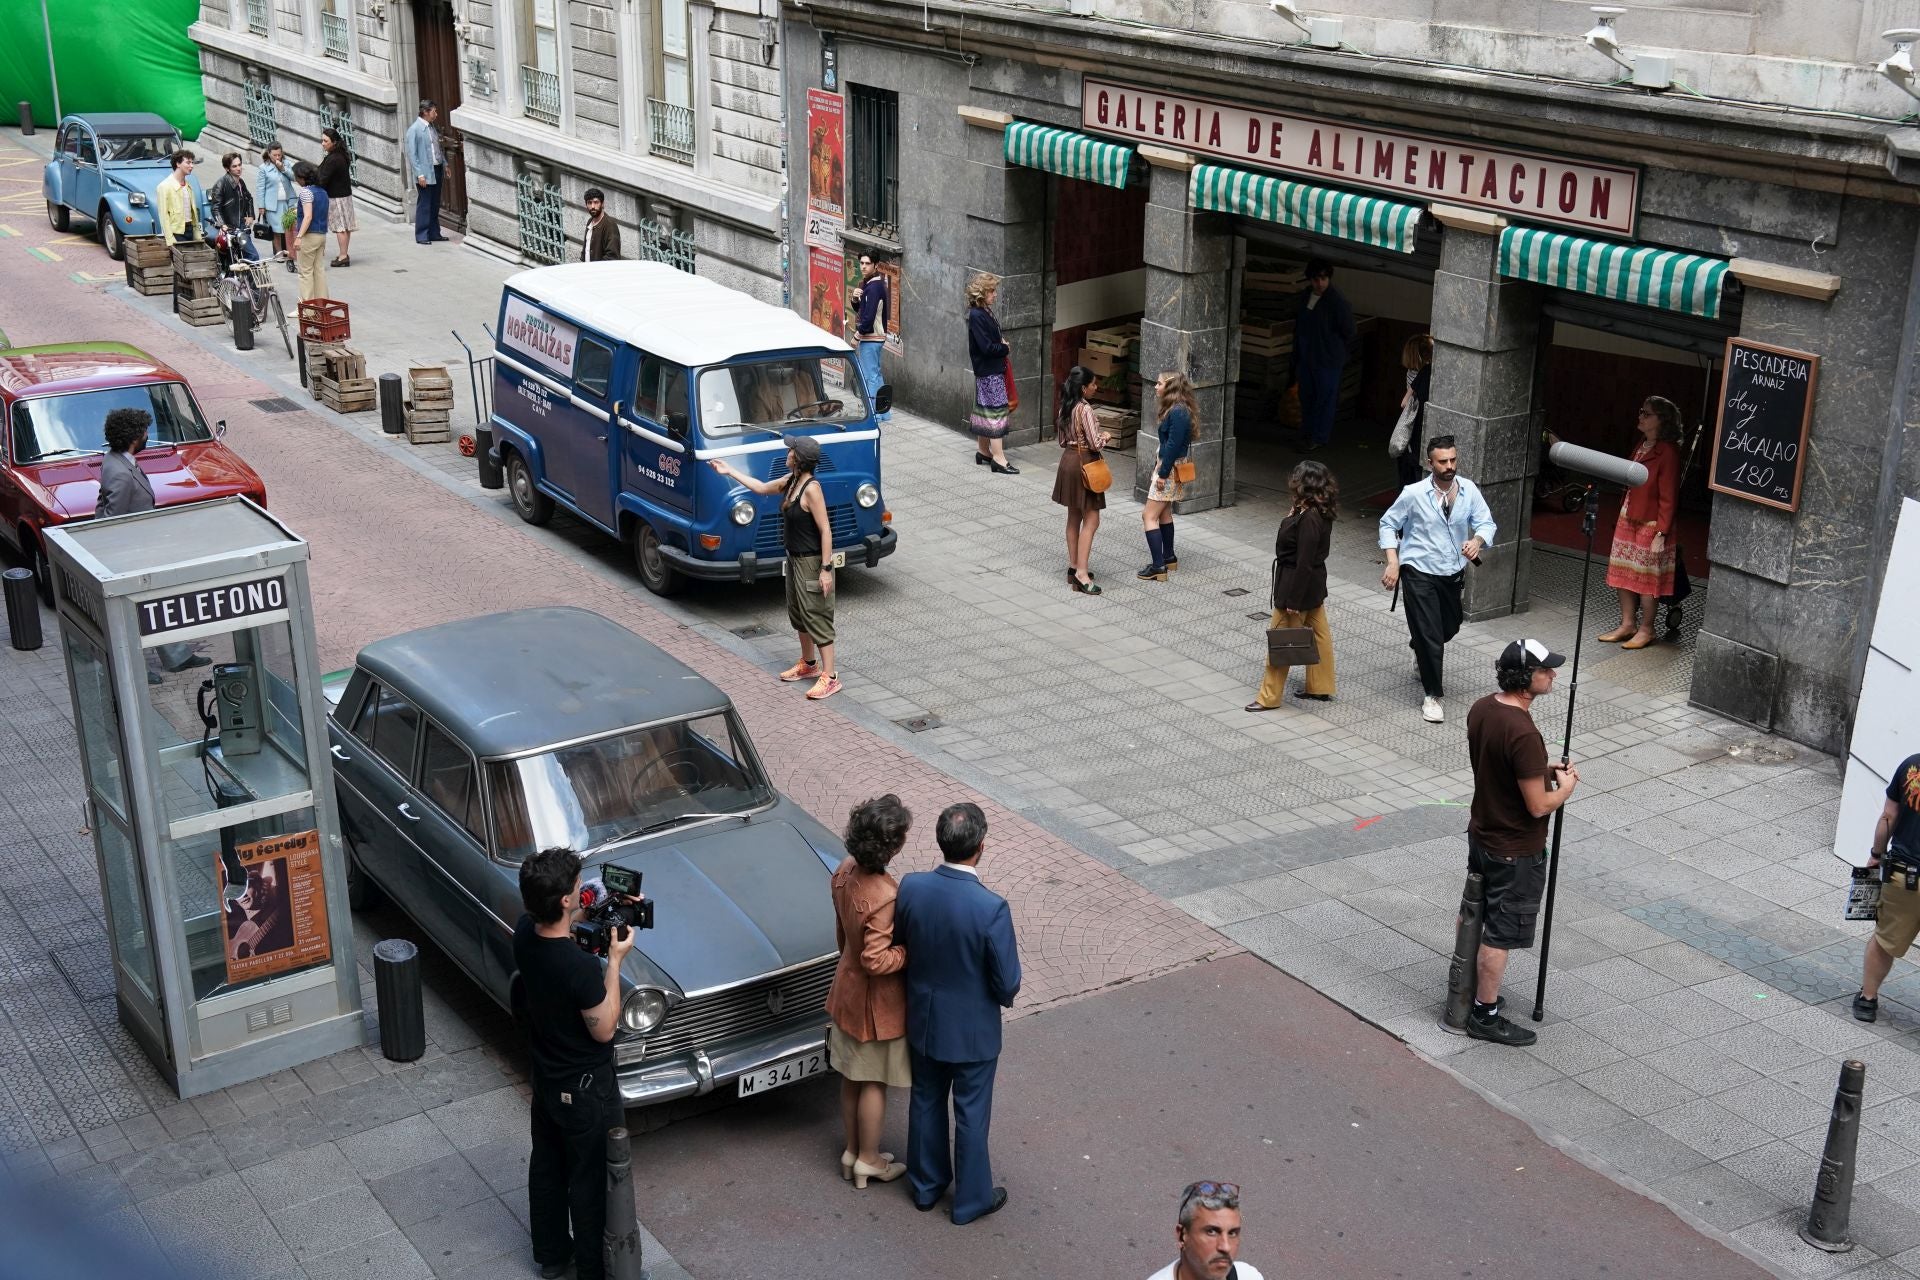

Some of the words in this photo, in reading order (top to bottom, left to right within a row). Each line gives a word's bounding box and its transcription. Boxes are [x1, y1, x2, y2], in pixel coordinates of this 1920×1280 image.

[1097, 90, 1221, 148] GALERIA
[1247, 117, 1283, 159] DE
[1307, 128, 1612, 220] ALIMENTACION
[810, 219, 820, 235] 23
[525, 313, 549, 334] FRUTAS
[507, 314, 572, 366] HORTALIZAS
[1724, 430, 1798, 463] BACALAO
[638, 464, 645, 475] 94
[656, 473, 665, 483] 23
[658, 453, 682, 476] GAS
[1731, 461, 1775, 488] 180
[143, 579, 282, 631] TELEFONO
[290, 858, 309, 869] STYLE
